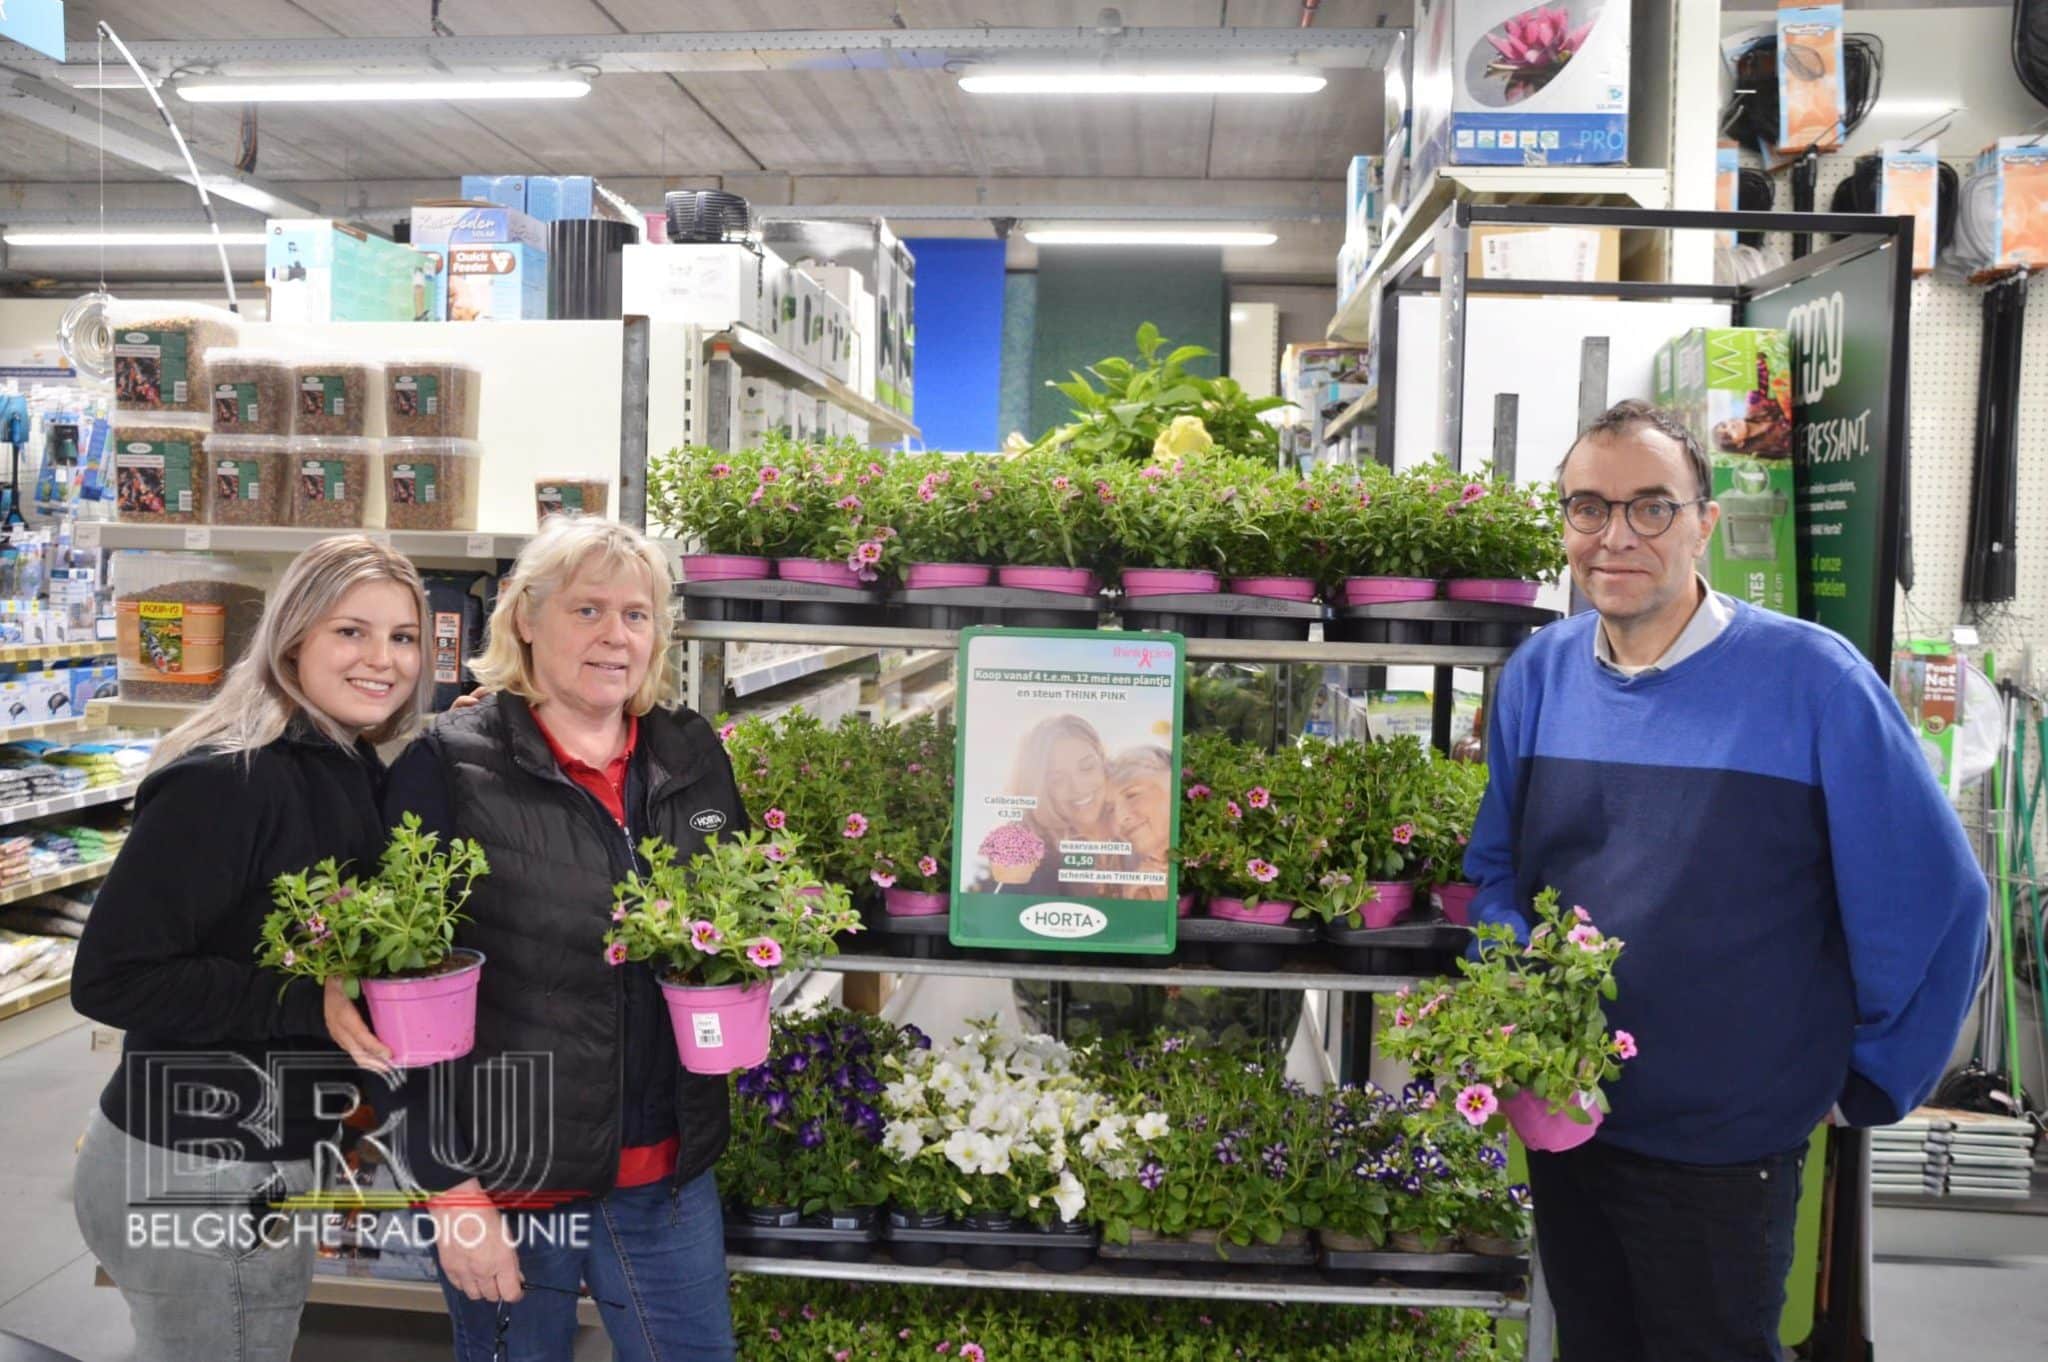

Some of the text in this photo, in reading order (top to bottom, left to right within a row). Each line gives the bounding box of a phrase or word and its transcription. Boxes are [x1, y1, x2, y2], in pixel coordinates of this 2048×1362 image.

[1580, 130, 1624, 152] PRO
[455, 252, 489, 262] Quick
[453, 263, 490, 273] Feeder
[1926, 663, 1957, 673] Pond
[975, 670, 1170, 687] Koop vanaf 4 t.e.m. 12 mei een plantje
[1925, 673, 1956, 687] Net
[1017, 689, 1127, 701] en steun THINK PINK
[984, 796, 1036, 806] Calibrachoa
[697, 815, 723, 826] HORTA
[1061, 843, 1130, 852] waarvan HORTA
[1064, 855, 1094, 866] €1,50
[1060, 870, 1165, 883] schenkt aan THINK PINK
[1035, 911, 1094, 928] HORTA
